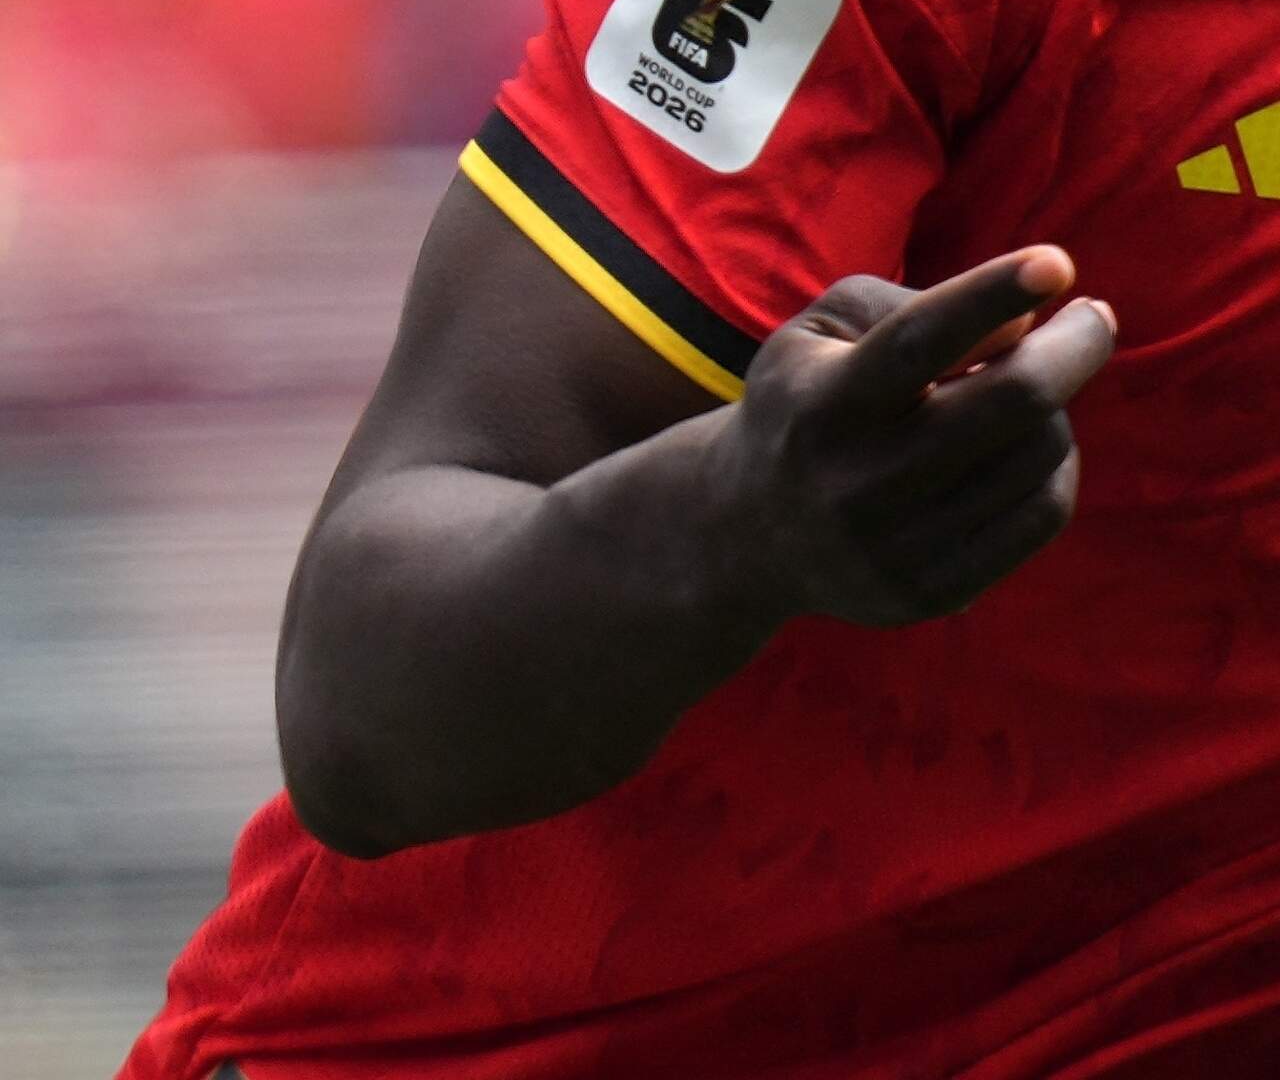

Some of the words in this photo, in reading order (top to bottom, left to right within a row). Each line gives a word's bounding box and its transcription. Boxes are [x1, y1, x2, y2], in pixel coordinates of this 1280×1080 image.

[667, 30, 709, 70] FIFA
[627, 70, 707, 133] 2026
[637, 52, 684, 93] WORLD
[685, 85, 716, 110] CUP
